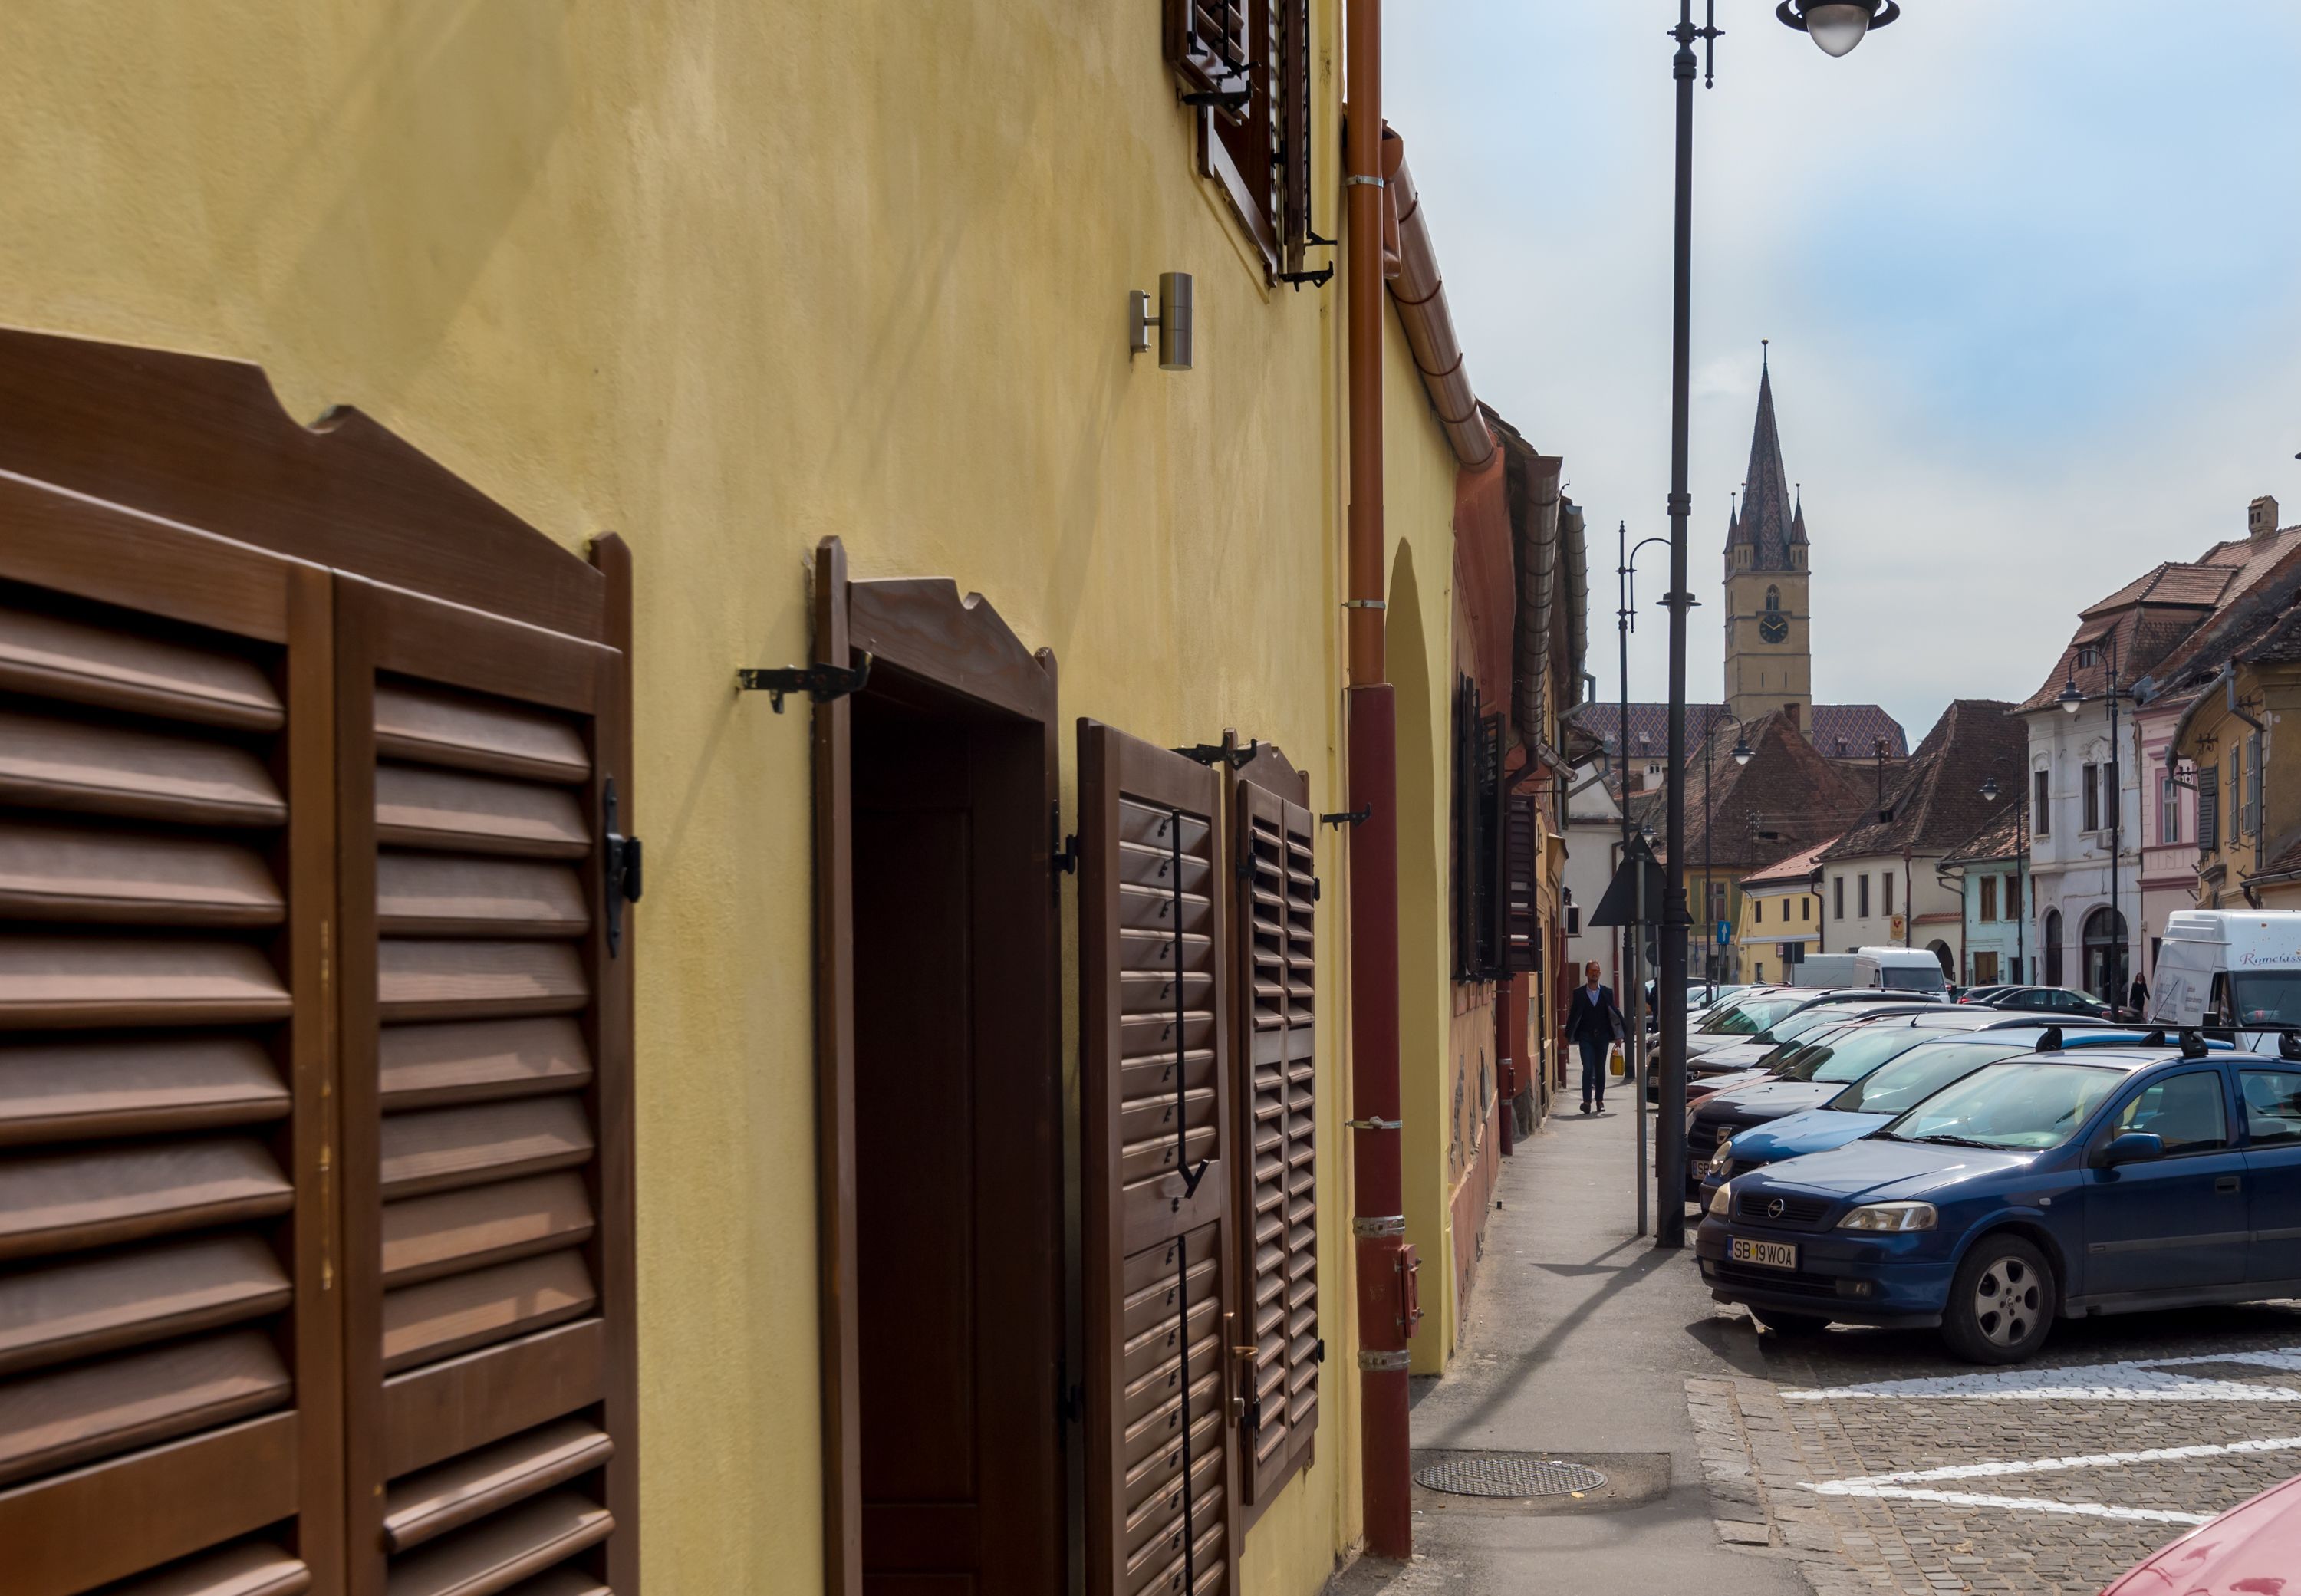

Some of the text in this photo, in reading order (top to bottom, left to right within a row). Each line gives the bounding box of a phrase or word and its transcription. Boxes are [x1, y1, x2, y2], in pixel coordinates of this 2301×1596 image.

[1734, 1241, 1792, 1265] SB 19 WOA
